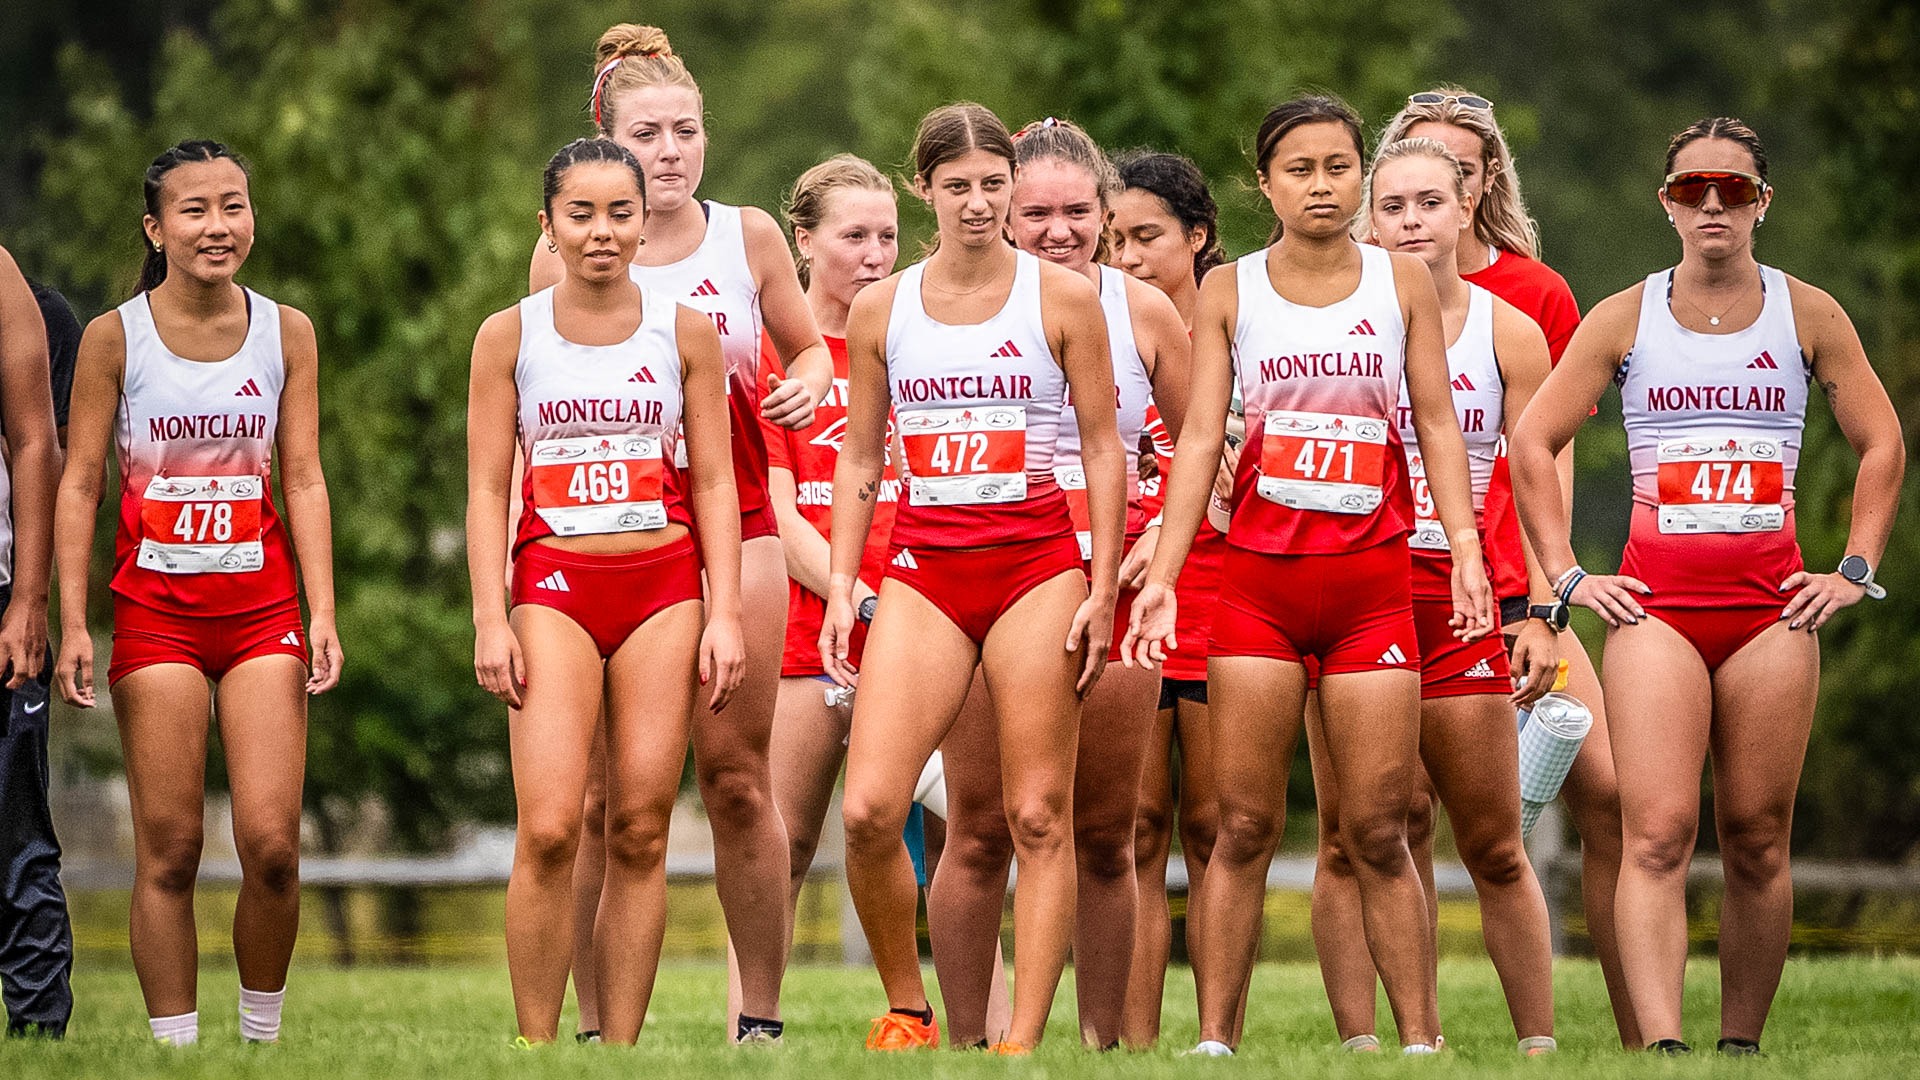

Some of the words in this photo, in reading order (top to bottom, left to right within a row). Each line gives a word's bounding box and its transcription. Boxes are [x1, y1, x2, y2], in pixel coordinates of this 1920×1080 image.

[1260, 352, 1383, 384] MONTCLAIR
[898, 375, 1032, 402] MONTCLAIR
[1648, 386, 1786, 412] MONTCLAIR
[538, 399, 663, 426] MONTCLAIR
[149, 414, 266, 442] MONTCLAIR
[930, 433, 988, 474] 472
[1294, 439, 1354, 481] 471
[568, 461, 629, 503] 469
[797, 481, 833, 506] ROS
[1691, 463, 1754, 501] 474
[173, 502, 232, 541] 478
[1464, 670, 1495, 678] adidas
